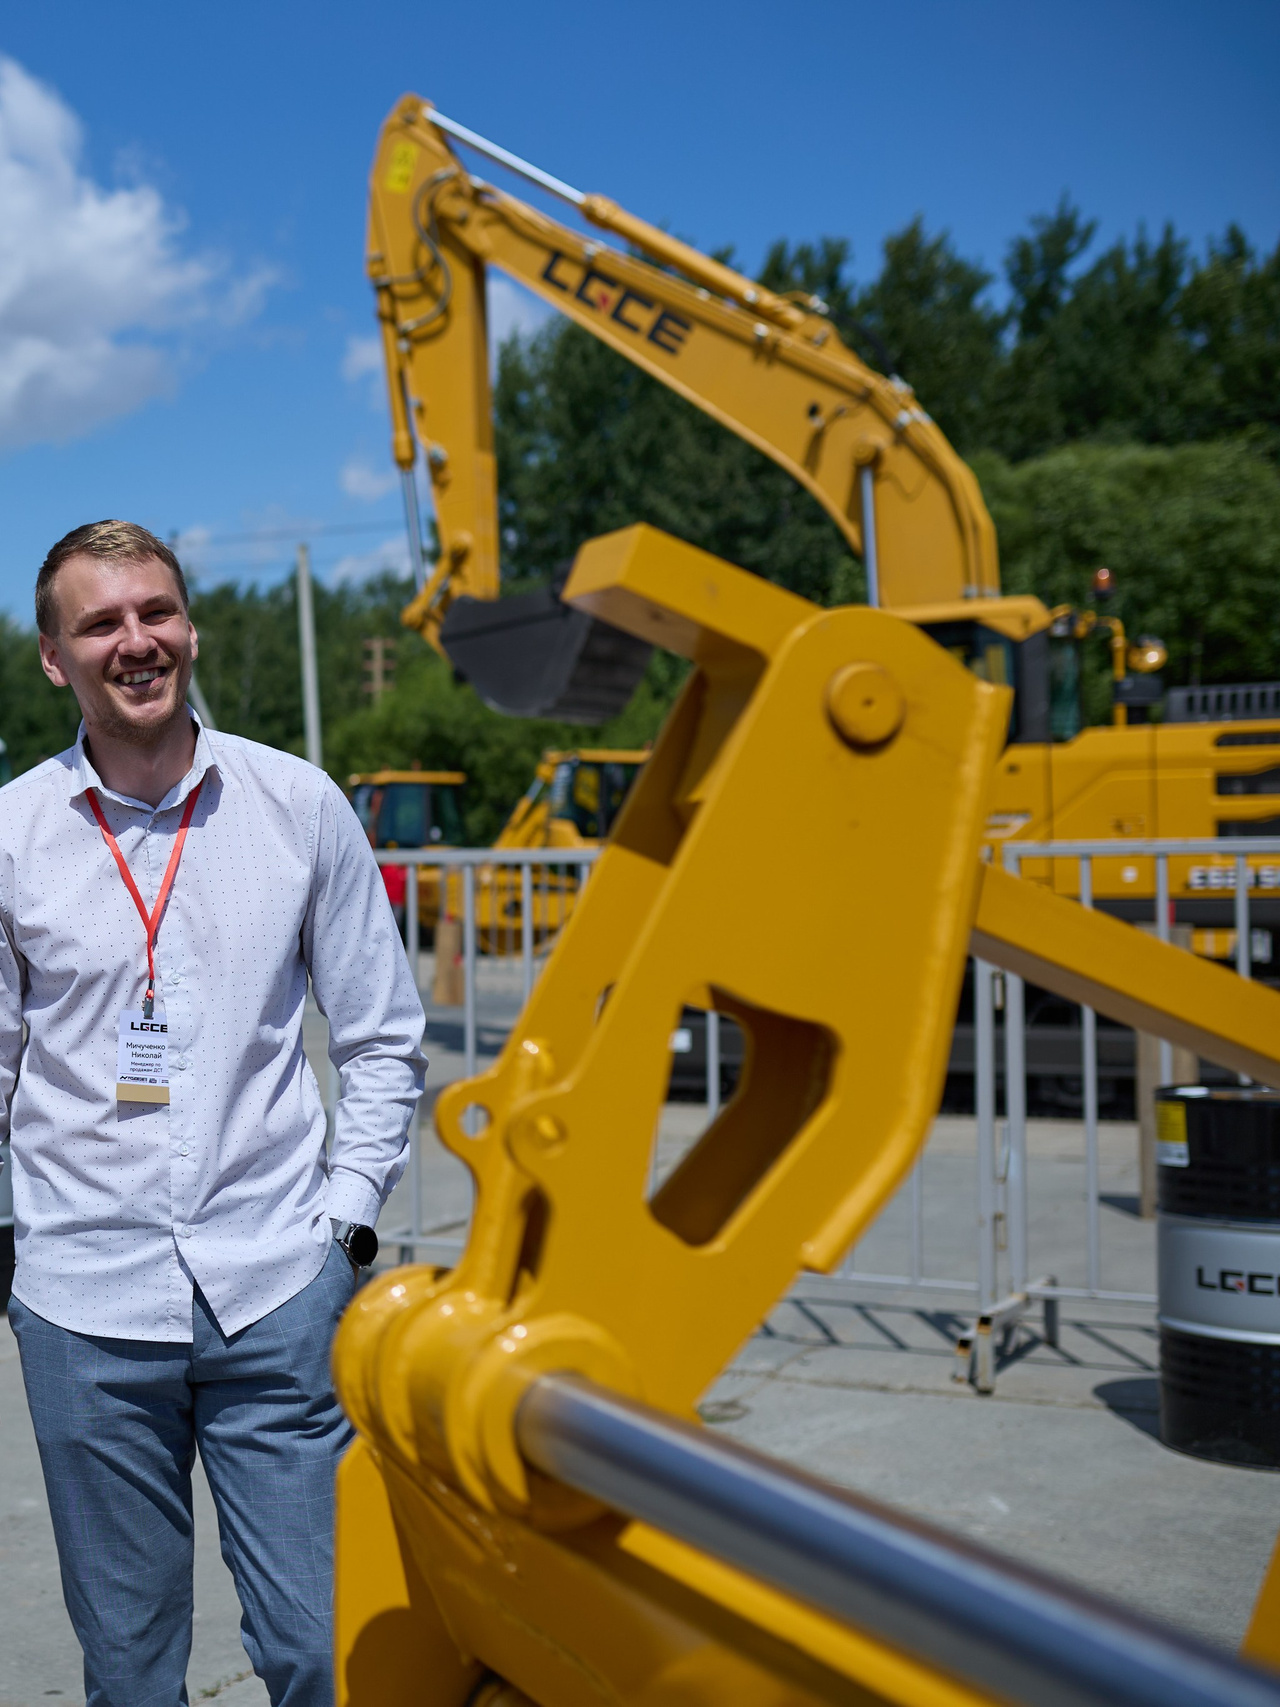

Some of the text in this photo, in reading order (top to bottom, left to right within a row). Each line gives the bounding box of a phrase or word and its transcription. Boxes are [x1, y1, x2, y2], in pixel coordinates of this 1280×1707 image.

[542, 252, 692, 355] LGCE
[130, 1021, 168, 1033] LGCE
[126, 1042, 166, 1051] Мичученко
[131, 1051, 162, 1059] Николай
